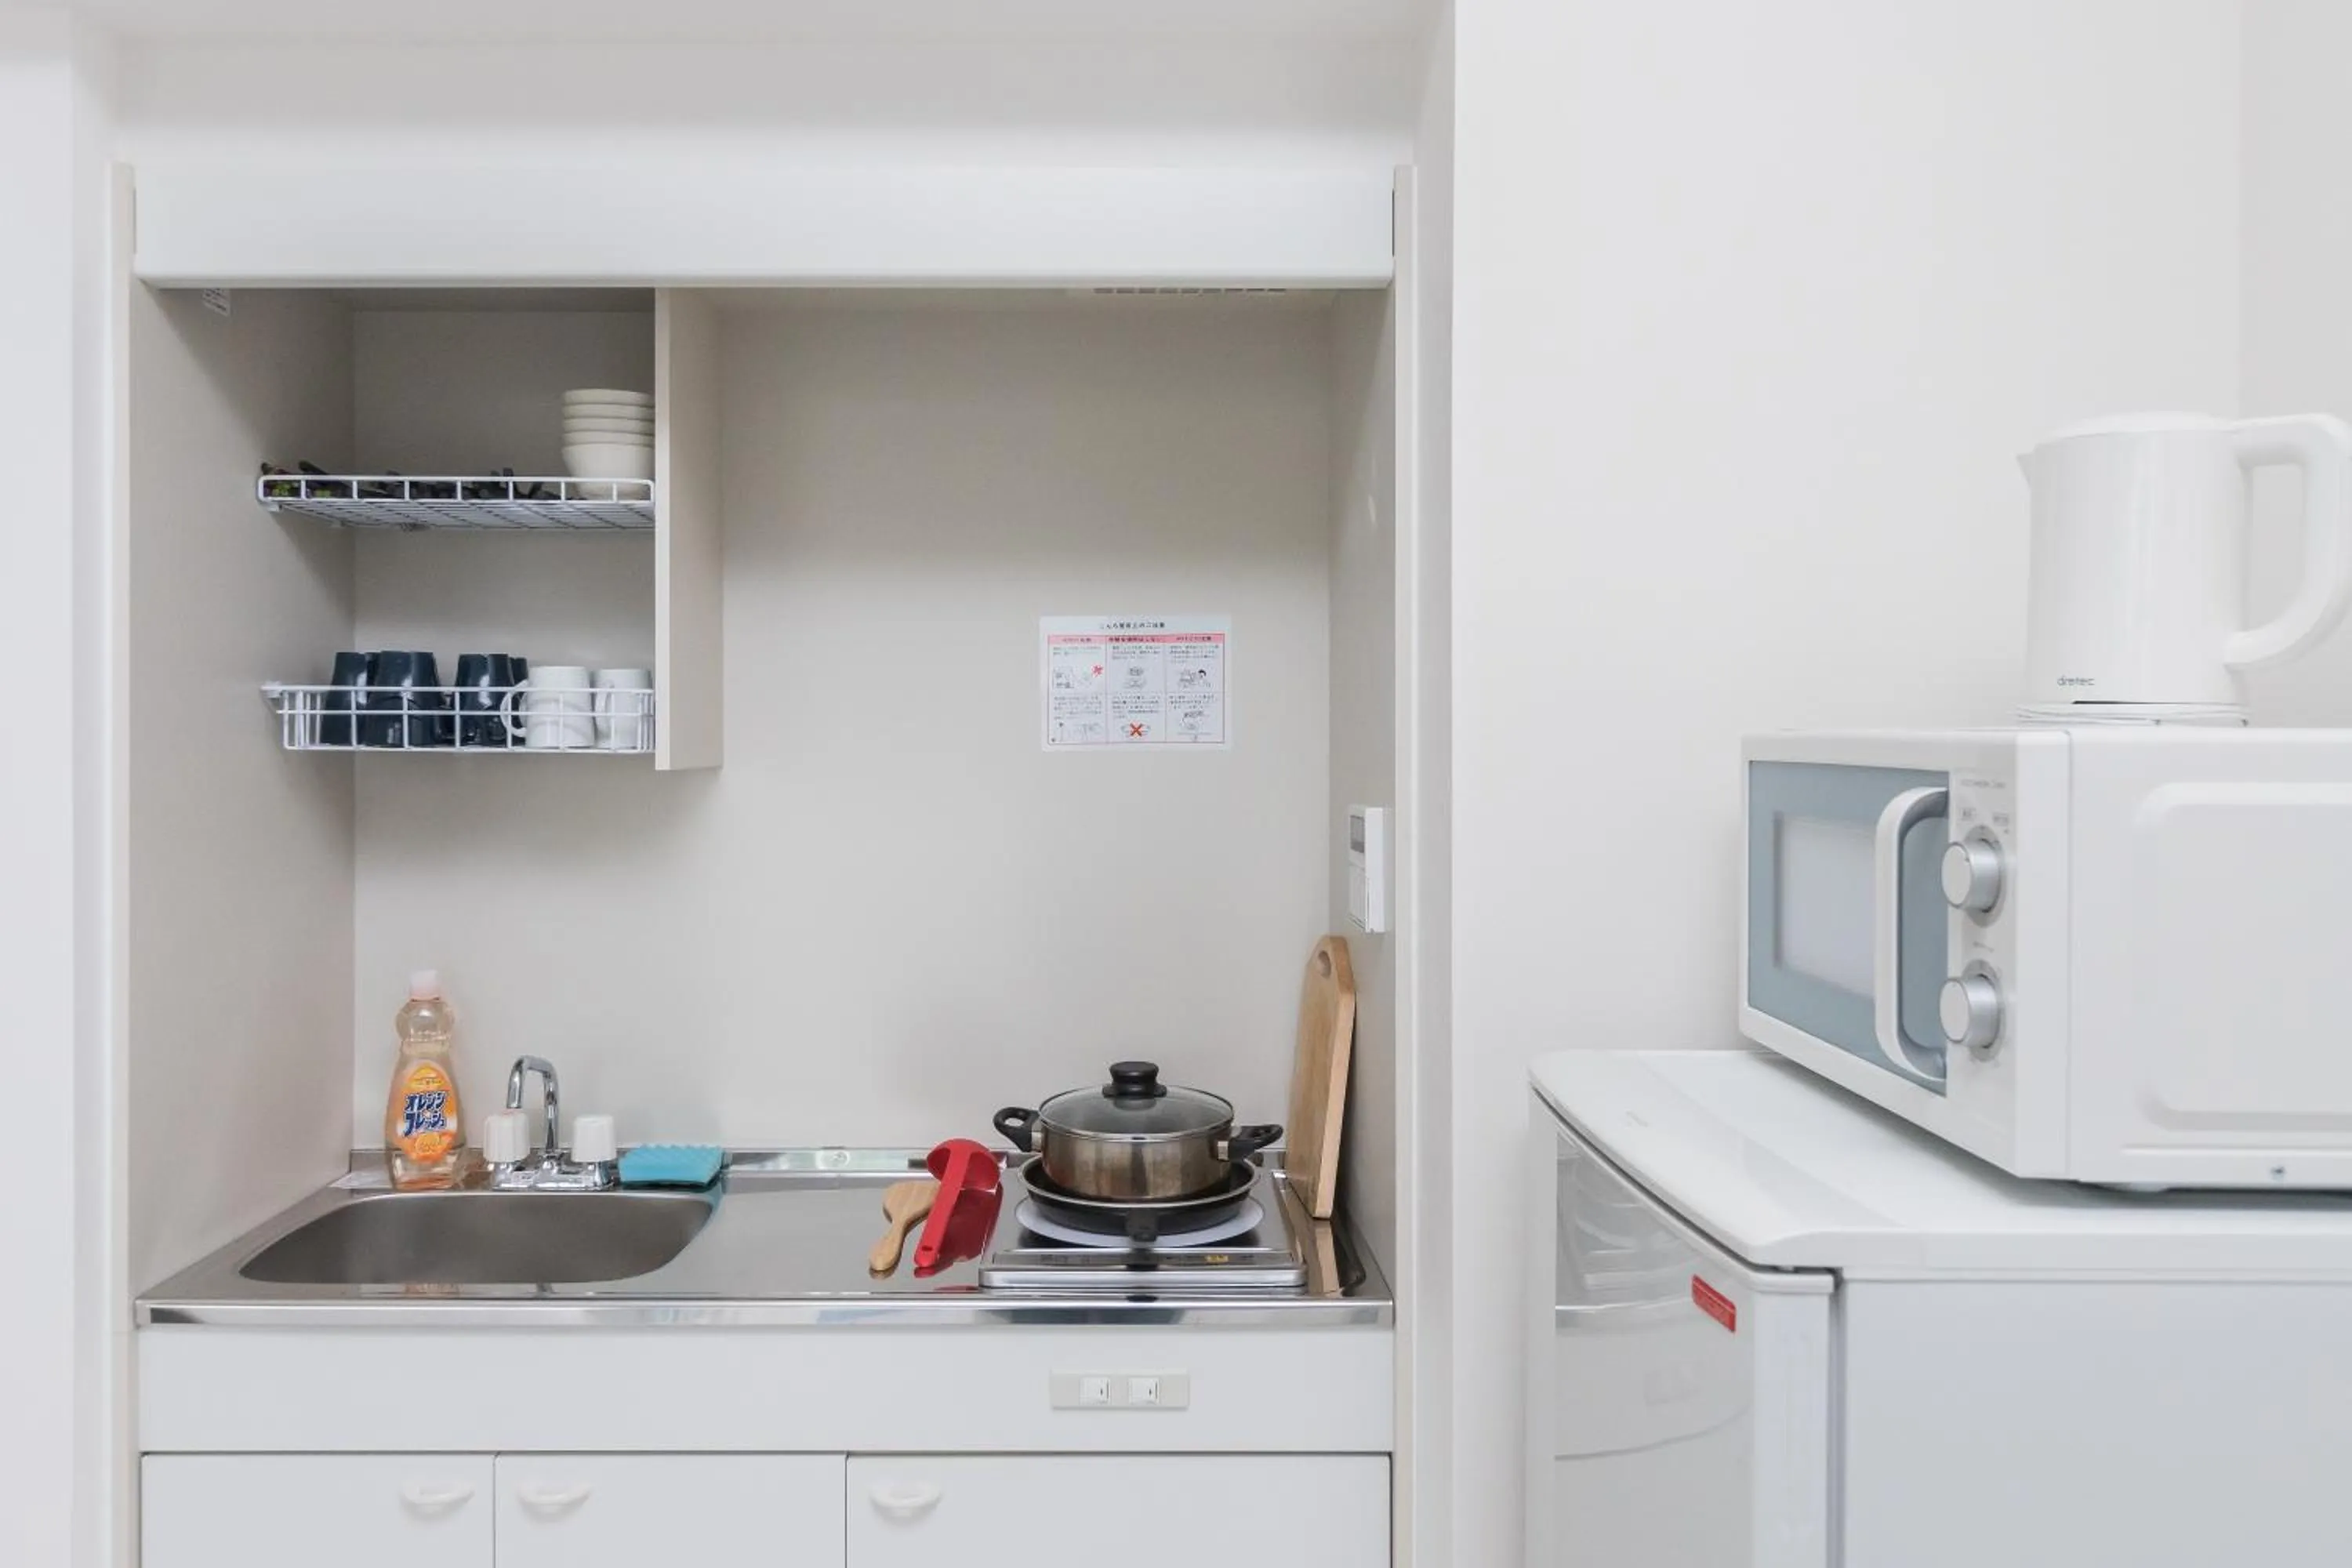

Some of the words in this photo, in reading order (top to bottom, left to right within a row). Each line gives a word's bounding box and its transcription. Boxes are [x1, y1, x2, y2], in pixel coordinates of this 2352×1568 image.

[2056, 674, 2096, 687] dretec
[403, 1091, 447, 1112] オレンジ
[402, 1110, 447, 1138] フレッシュ
